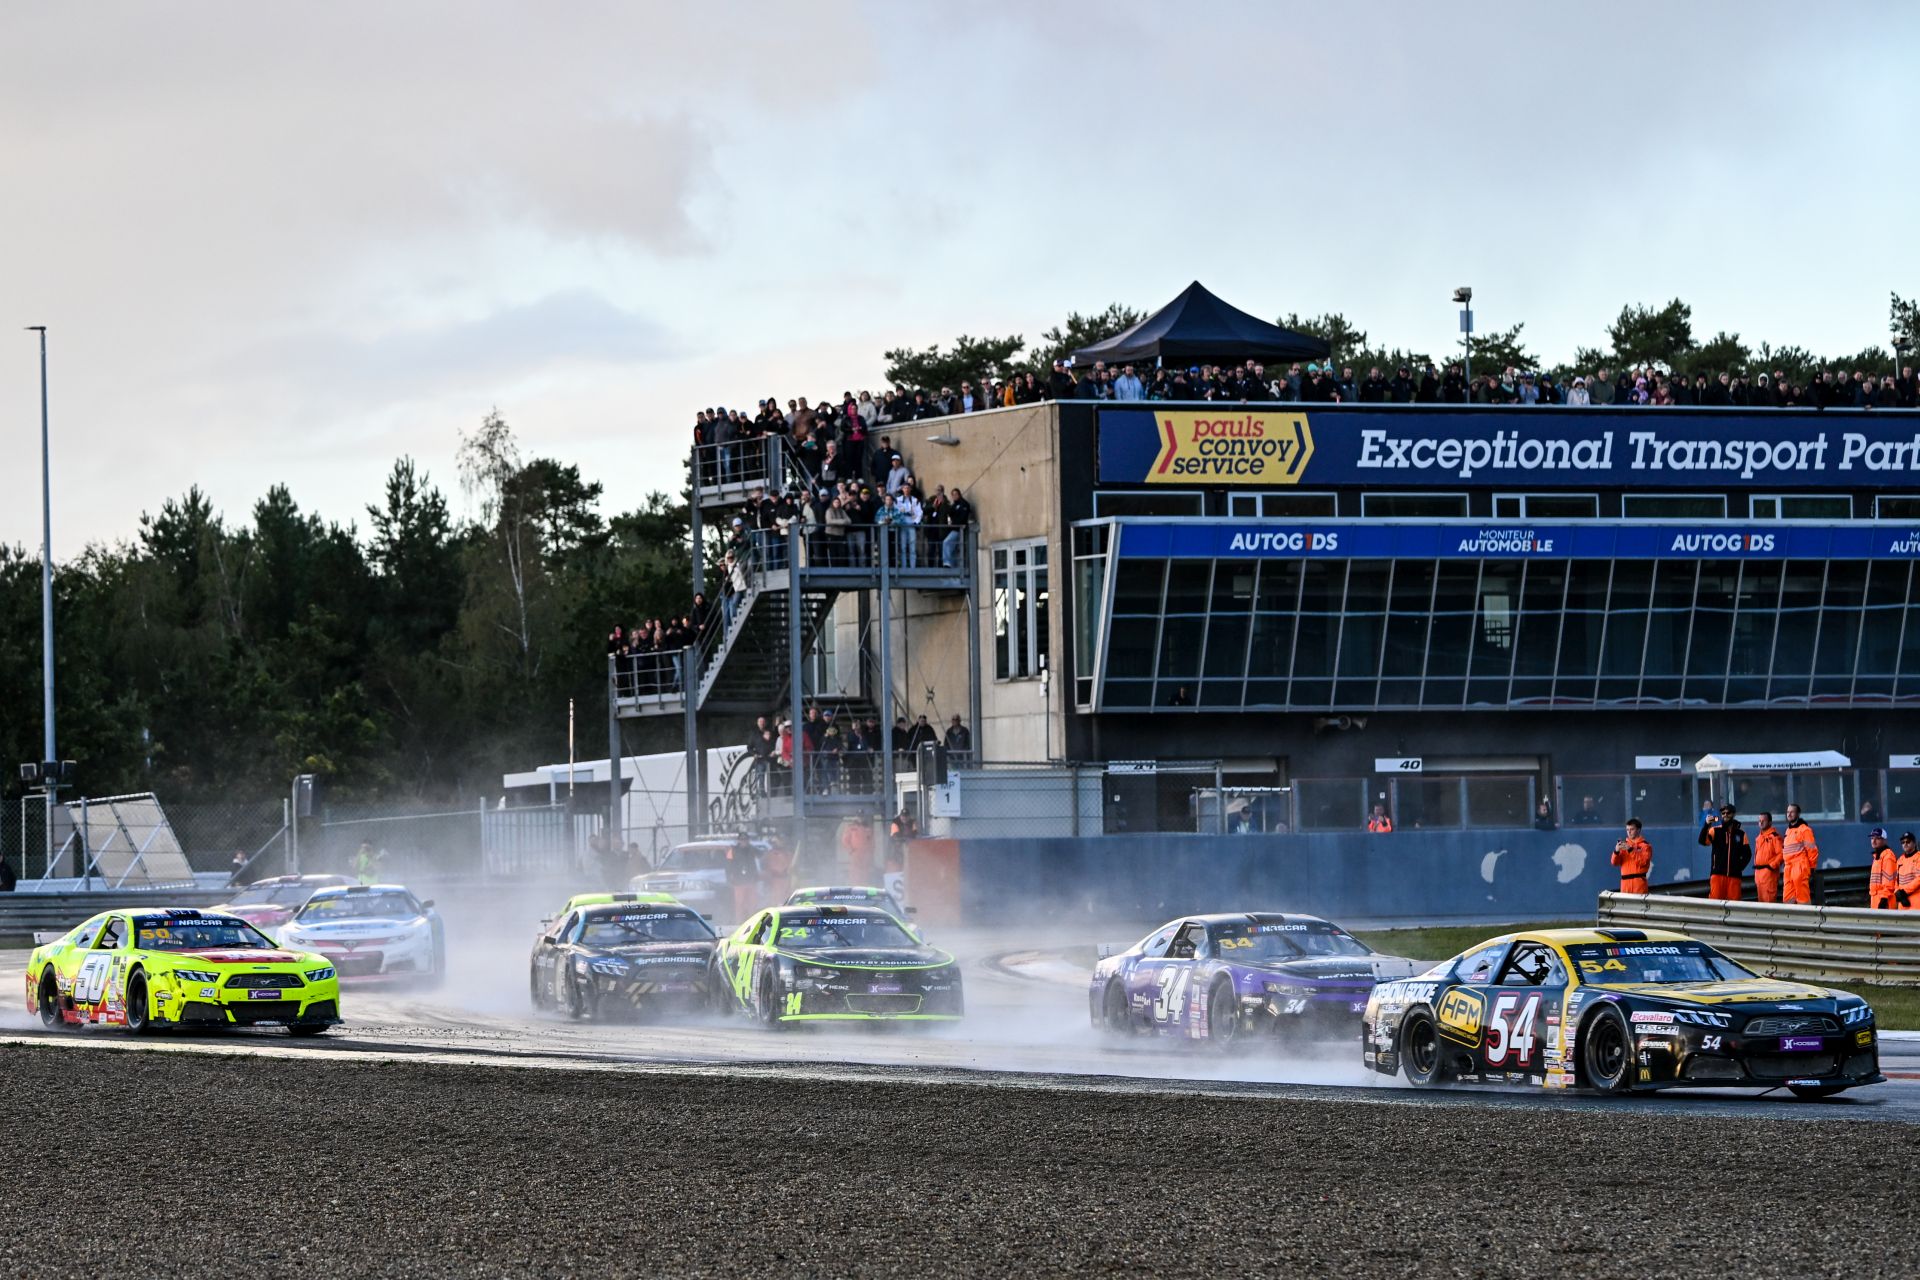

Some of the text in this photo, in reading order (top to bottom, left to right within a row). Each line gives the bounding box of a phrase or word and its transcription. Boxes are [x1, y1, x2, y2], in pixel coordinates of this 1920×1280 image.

[1191, 415, 1265, 443] pauls
[1199, 438, 1294, 462] convoy
[1357, 429, 1920, 480] Exceptional Transport Part
[1172, 456, 1265, 475] service
[1479, 530, 1535, 540] MONITEUR
[1458, 539, 1553, 552] AUTOMOBILE
[1399, 759, 1421, 770] 40
[1659, 757, 1681, 768] 39
[1752, 760, 1822, 770] www.raceplanet.nl
[944, 792, 950, 804] 1
[624, 913, 669, 921] NASCAR
[140, 928, 170, 940] 50
[780, 927, 807, 938] 24
[1218, 937, 1256, 949] 34
[1624, 946, 1682, 955] NASCAR
[1578, 958, 1628, 973] 54
[199, 988, 216, 998] 50
[1154, 964, 1193, 1025] 34
[1284, 999, 1307, 1014] 34
[1441, 993, 1480, 1029] HPM
[1638, 1012, 1672, 1022] cavallaro
[1486, 993, 1542, 1066] 54
[1701, 1035, 1722, 1050] 54
